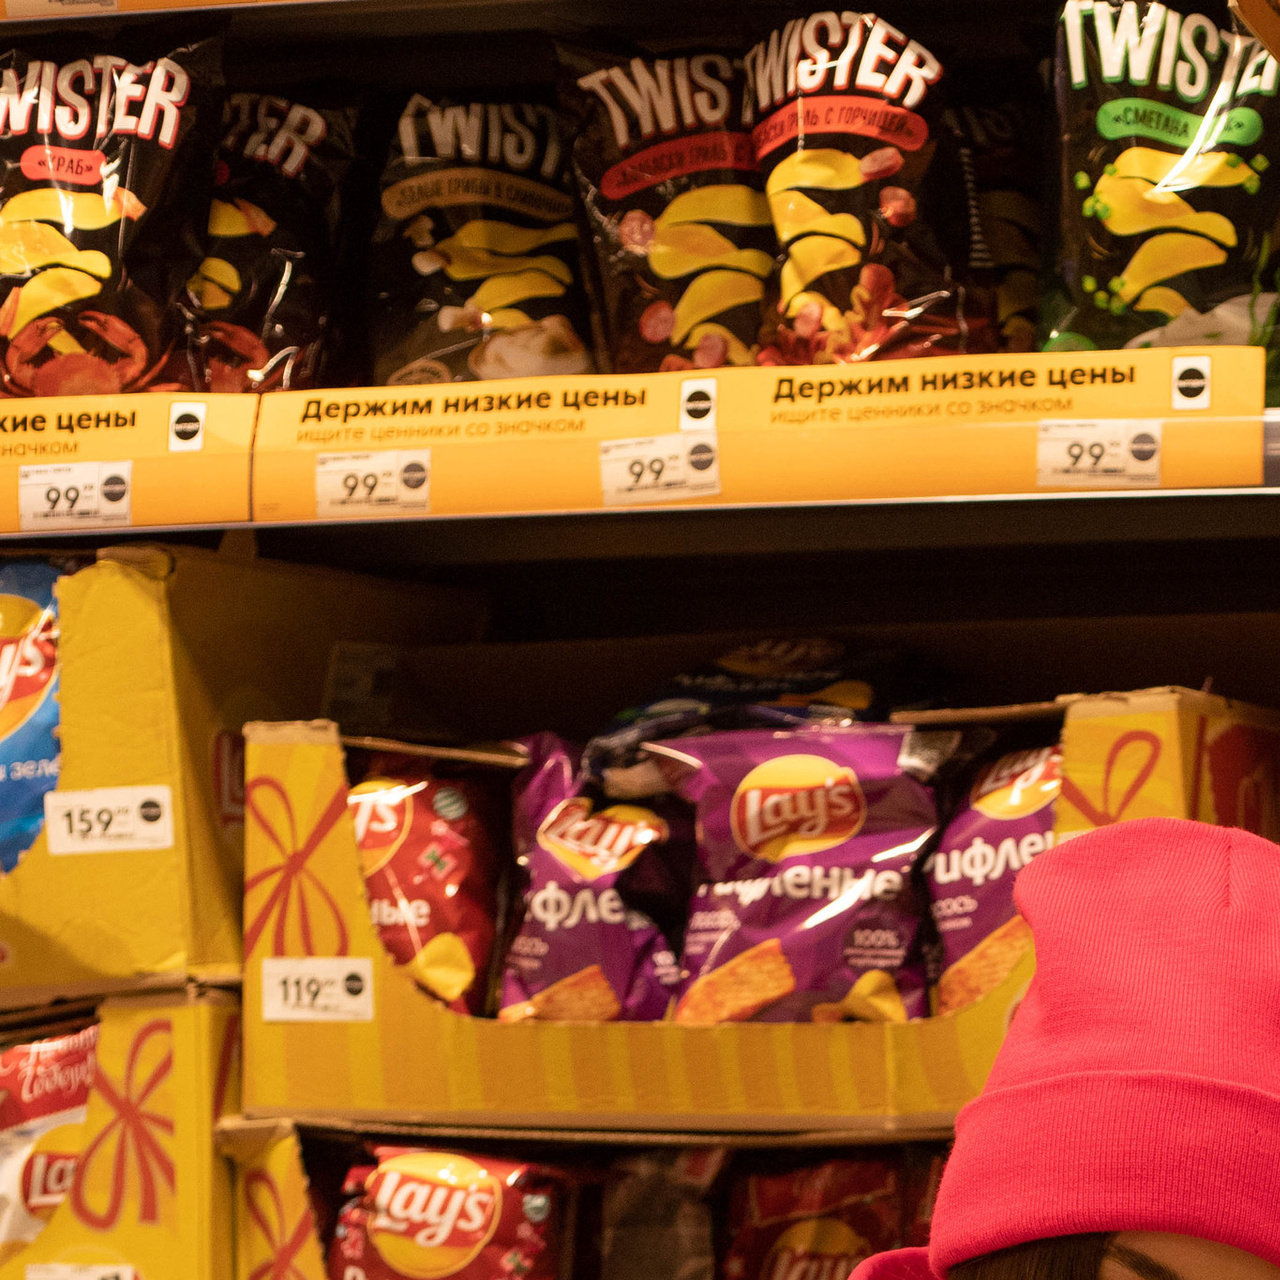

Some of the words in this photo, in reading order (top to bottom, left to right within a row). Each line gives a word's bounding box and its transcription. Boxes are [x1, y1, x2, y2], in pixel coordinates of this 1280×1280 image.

[741, 10, 943, 126] TWISTER
[773, 376, 909, 403] Держим
[921, 369, 1036, 392] низкие
[1048, 365, 1135, 387] цены
[301, 391, 432, 422] Держим
[444, 389, 551, 415] низкие
[561, 387, 646, 410] цены
[57, 411, 136, 434] цены
[1067, 443, 1105, 467] 99
[343, 472, 378, 496] 99
[629, 458, 664, 484] 99
[45, 486, 80, 510] 99
[63, 808, 114, 835] 159
[745, 777, 857, 846] Lay's
[280, 976, 321, 1002] 119
[374, 1171, 492, 1248] Lay's
